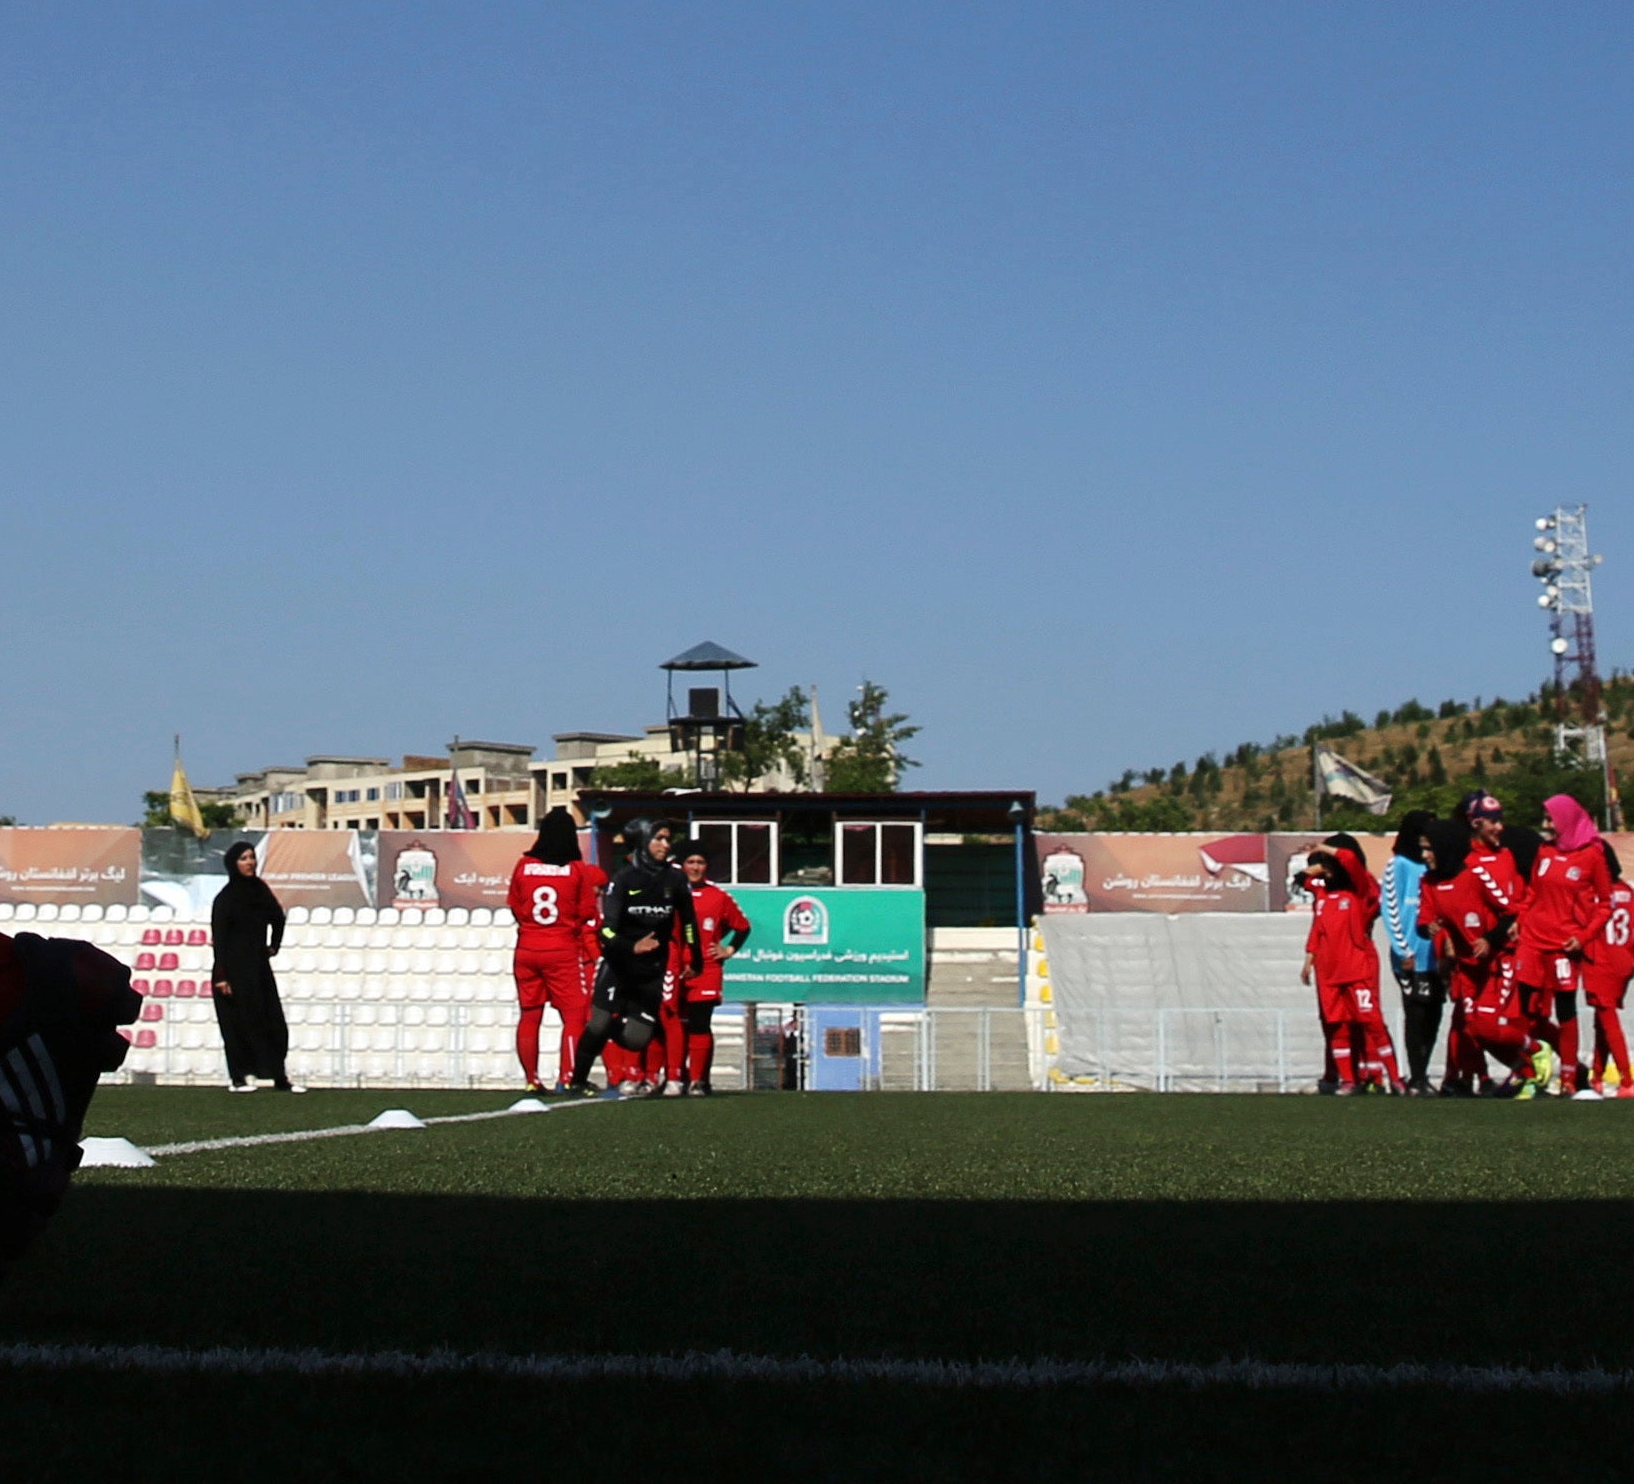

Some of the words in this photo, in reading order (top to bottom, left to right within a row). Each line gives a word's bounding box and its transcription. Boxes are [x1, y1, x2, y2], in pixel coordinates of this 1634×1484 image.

[532, 886, 558, 925] 8
[1605, 908, 1631, 946] 13
[765, 973, 811, 983] FOOTBALL
[812, 973, 868, 984] FEDERATION
[869, 974, 910, 984] STADIUM
[1555, 958, 1571, 979] 10
[1355, 989, 1373, 1009] 12
